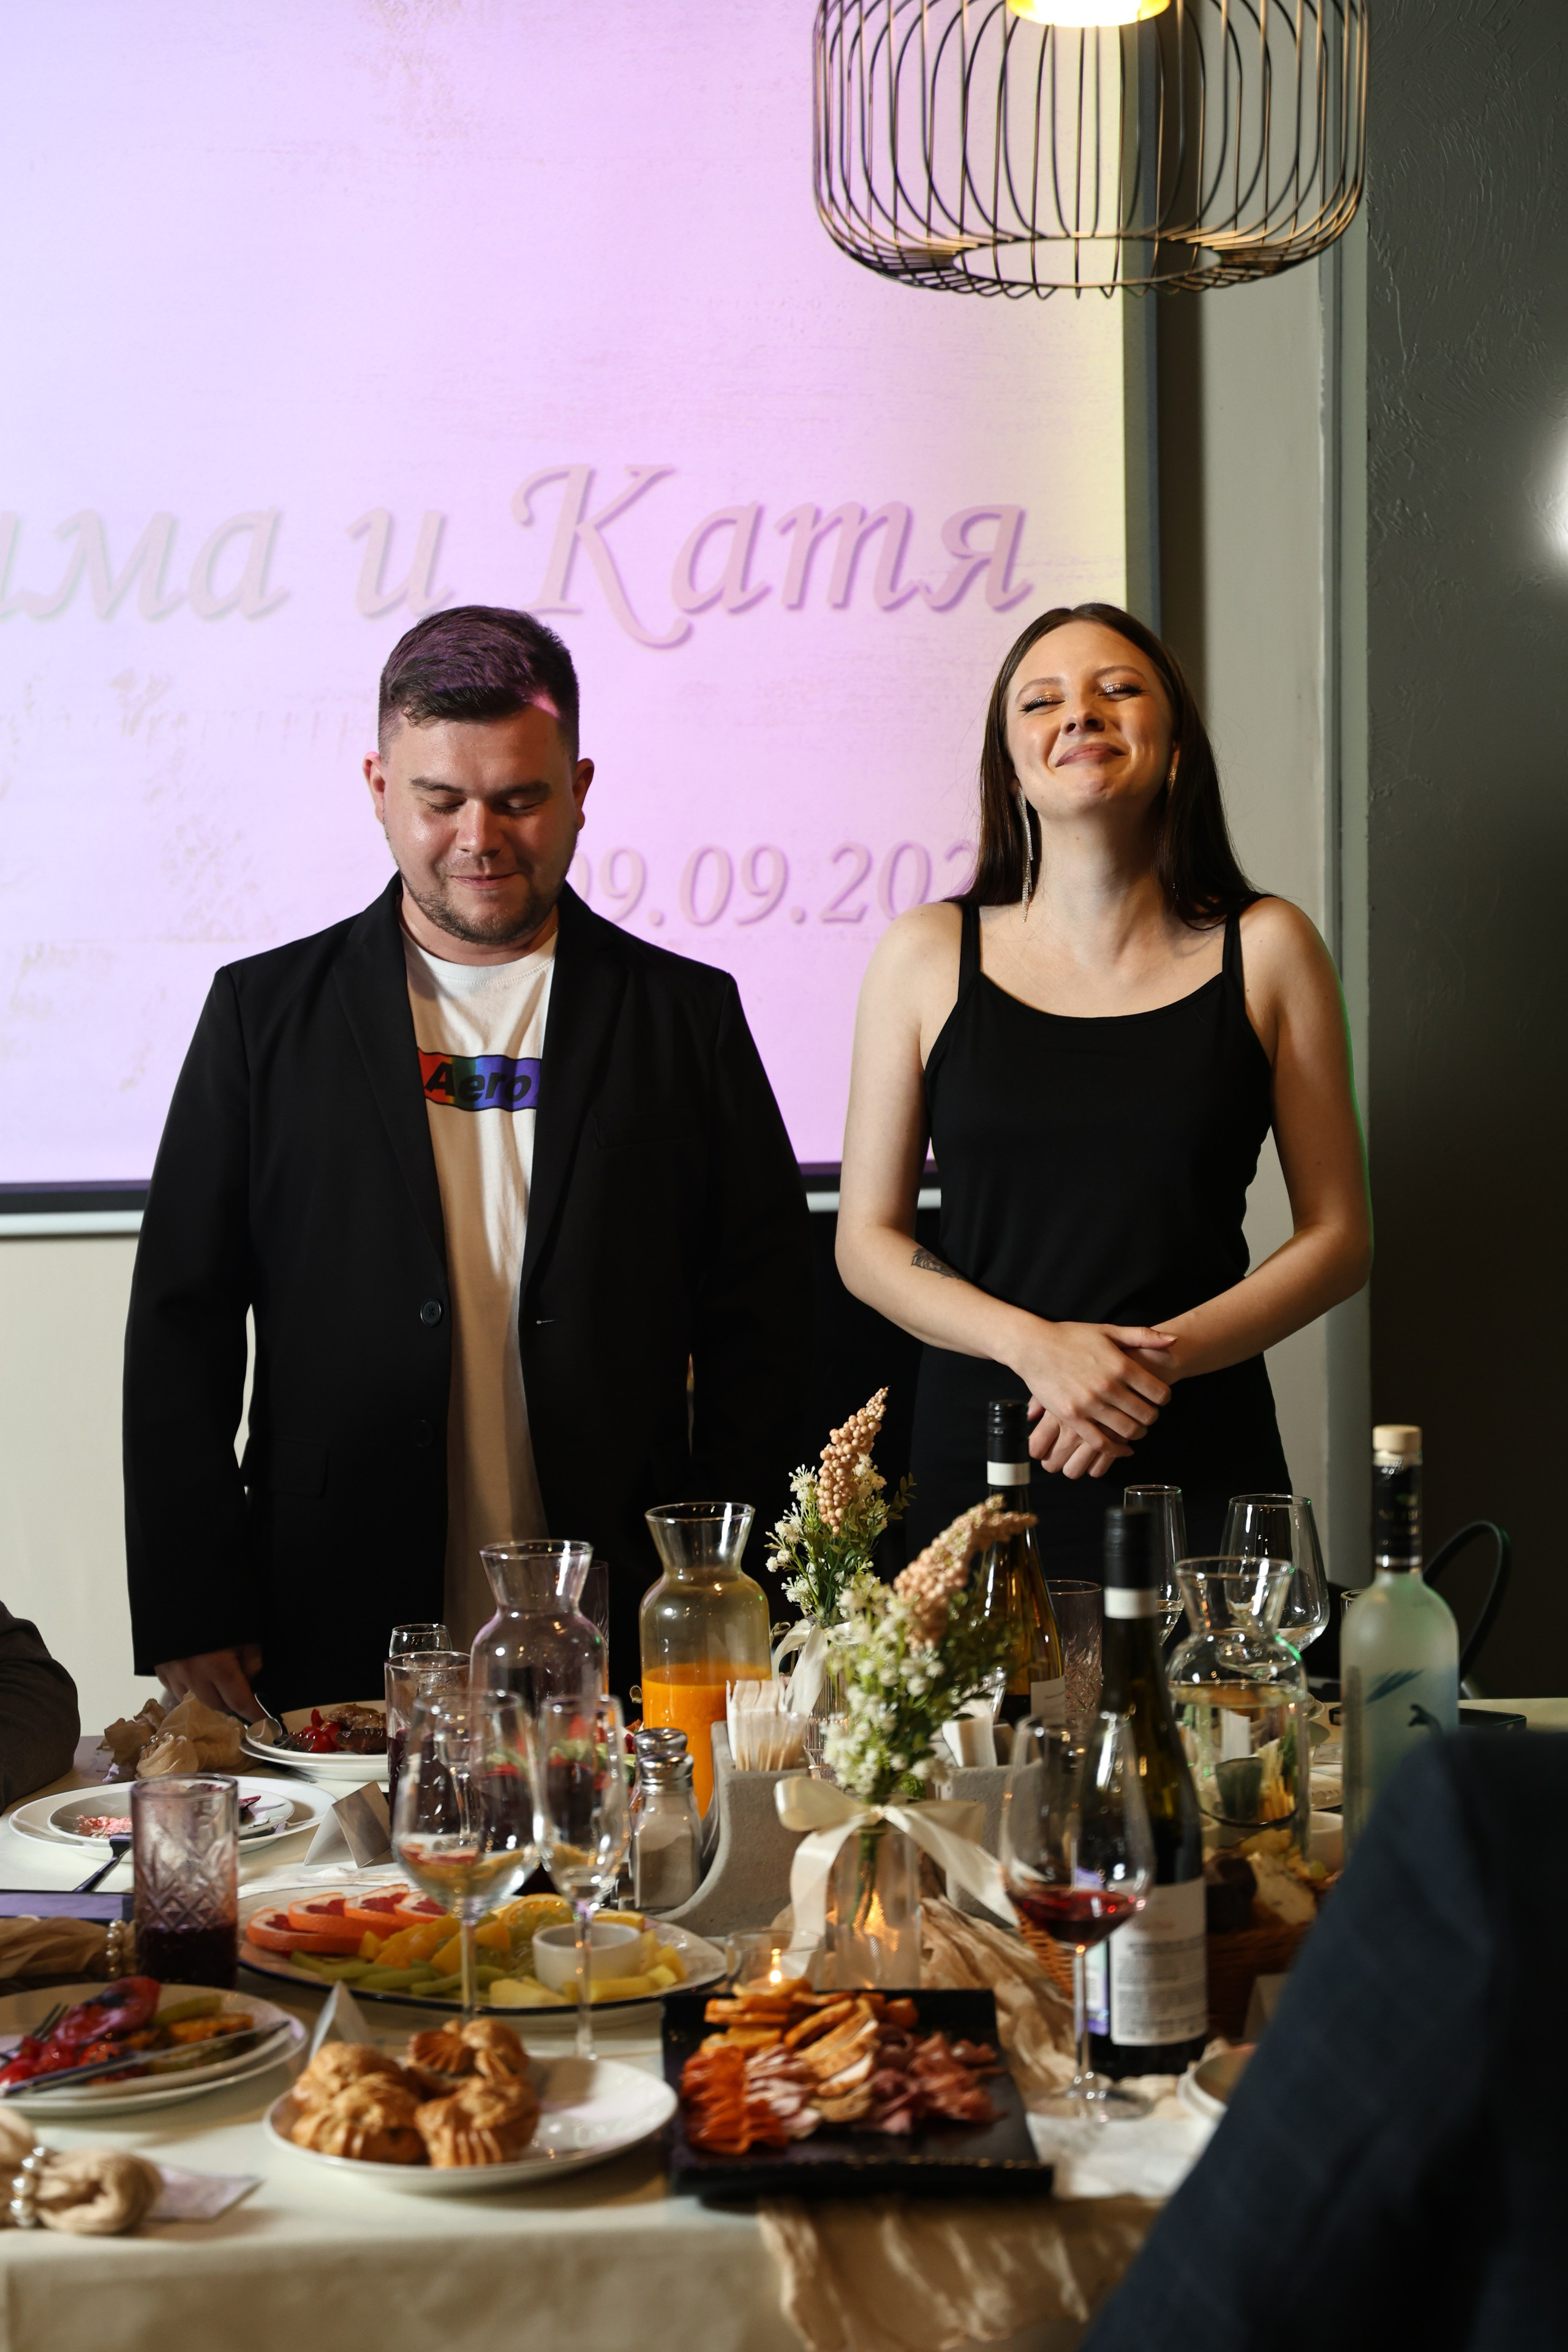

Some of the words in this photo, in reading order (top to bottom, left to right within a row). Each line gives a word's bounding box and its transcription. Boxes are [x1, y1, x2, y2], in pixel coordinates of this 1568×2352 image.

[346, 507, 455, 619] и
[511, 463, 1034, 650] Катя
[424, 1061, 532, 1102] Aero
